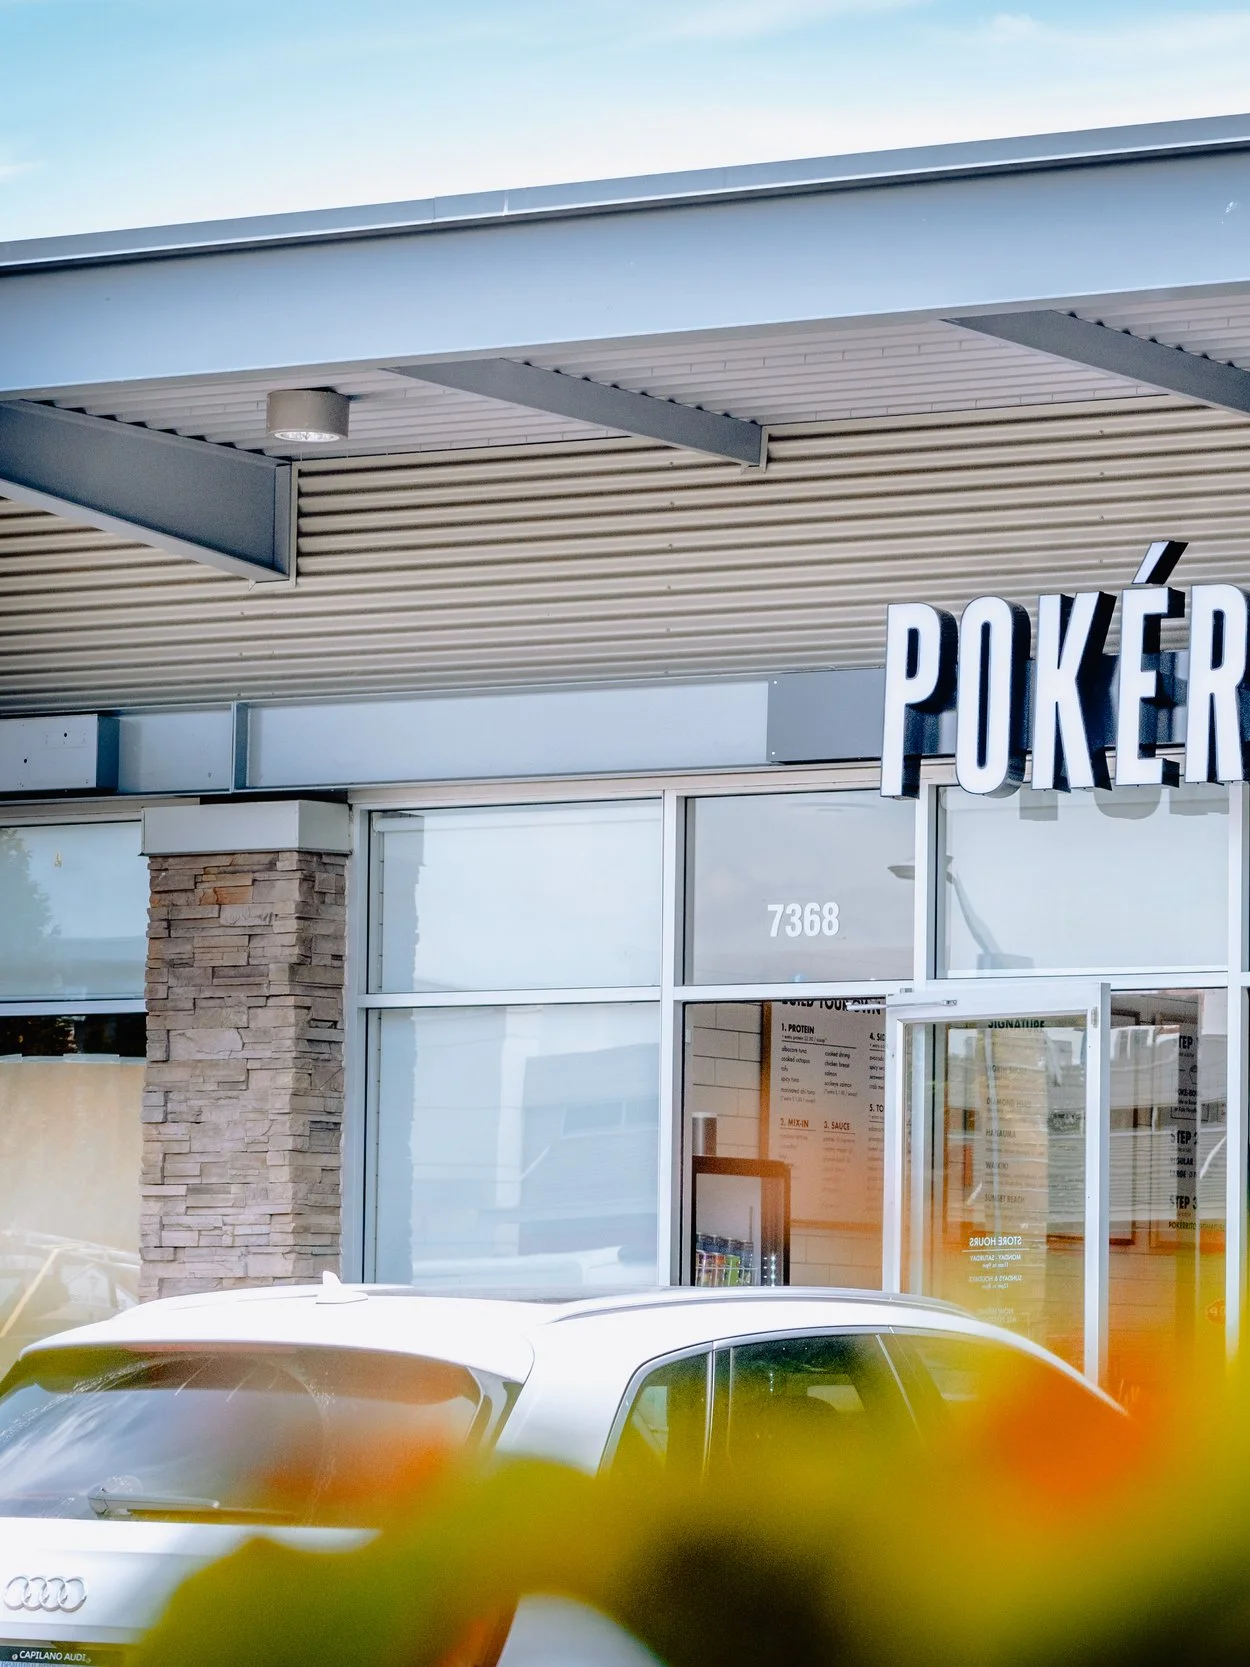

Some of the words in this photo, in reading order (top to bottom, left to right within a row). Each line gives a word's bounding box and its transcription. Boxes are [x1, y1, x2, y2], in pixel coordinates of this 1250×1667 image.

[767, 901, 839, 938] 7368
[788, 1024, 815, 1034] PROTEIN
[1178, 1035, 1193, 1049] TEP
[788, 1119, 809, 1128] MIX-IN
[831, 1122, 850, 1131] SAUCE
[19, 1650, 63, 1660] CAPILANO
[64, 1652, 87, 1662] AUDI
